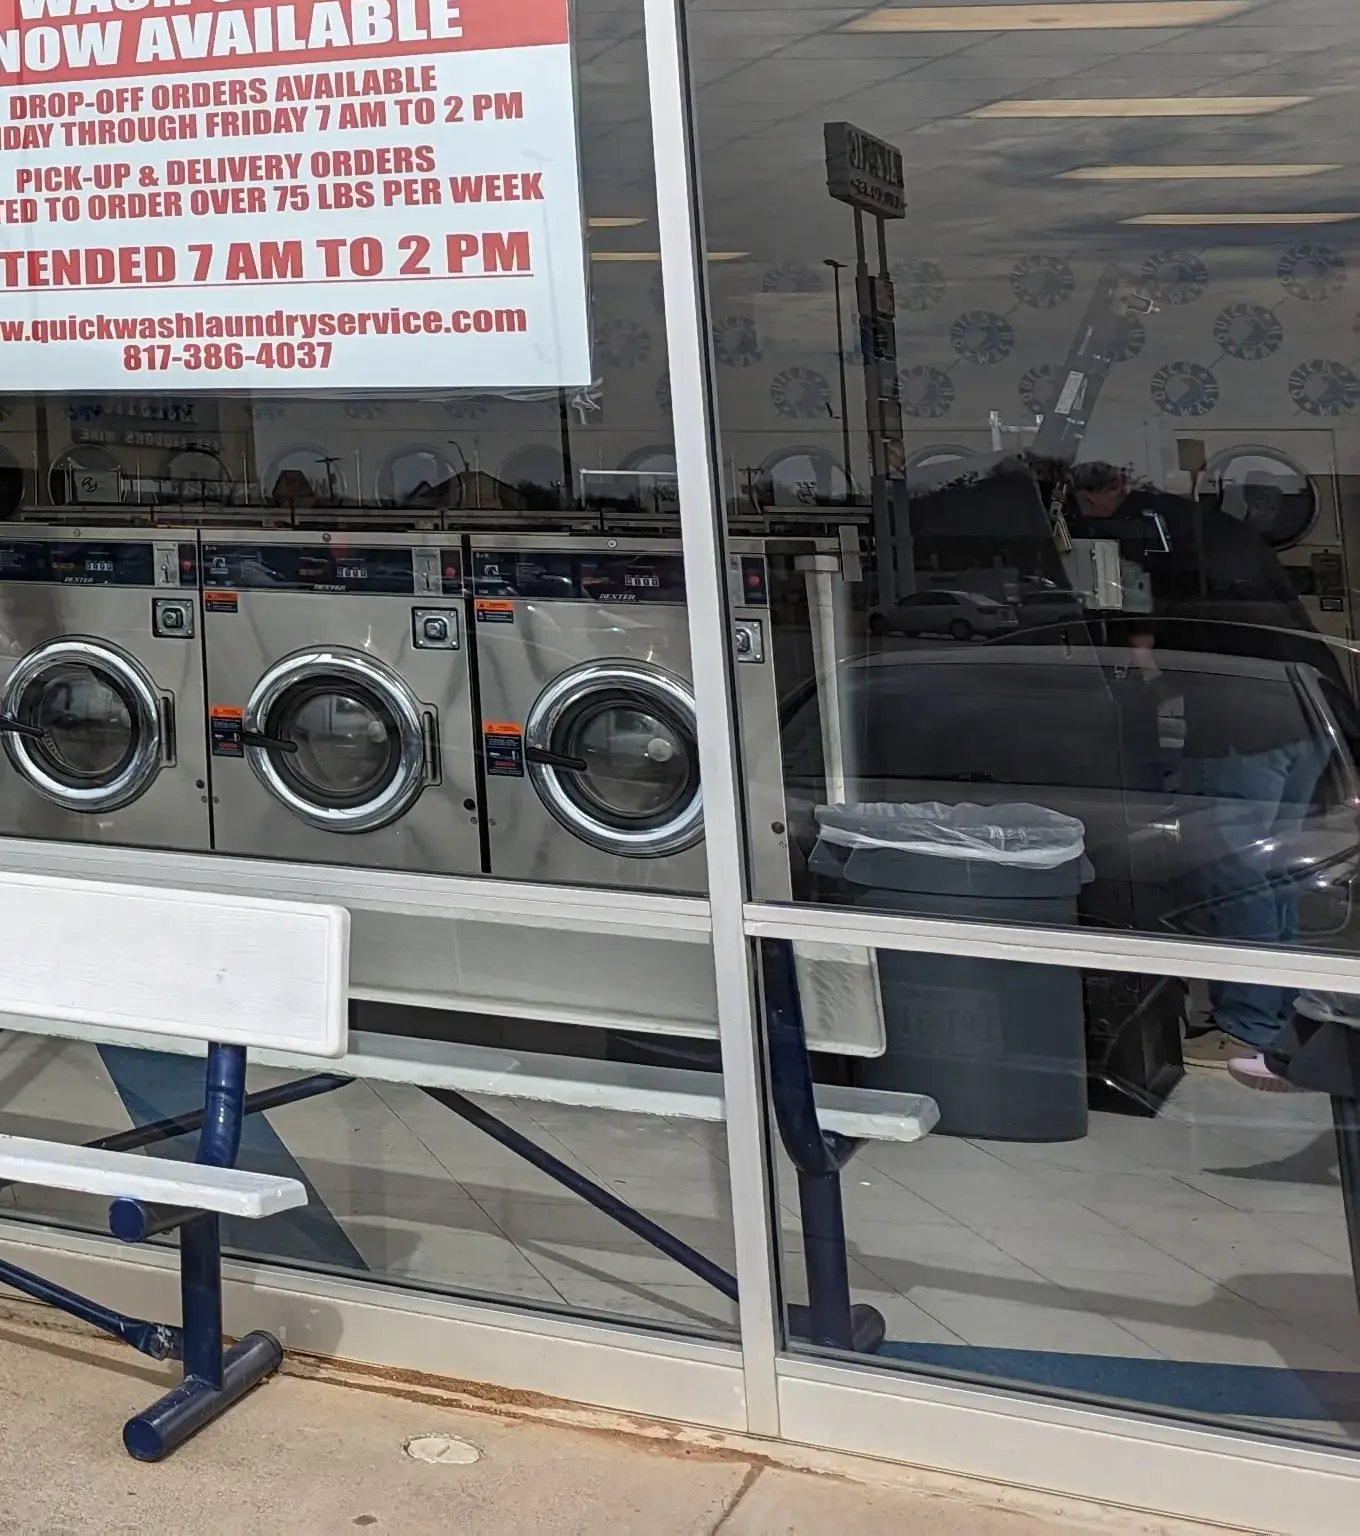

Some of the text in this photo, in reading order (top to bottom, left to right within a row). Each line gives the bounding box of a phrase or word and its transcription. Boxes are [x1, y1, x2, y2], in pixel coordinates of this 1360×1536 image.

[9, 66, 436, 121] DROP-OFF ORDERS AVAILABLE
[62, 115, 196, 149] THROUGH
[206, 108, 308, 139] FRIDAY
[316, 106, 330, 132] 7
[338, 102, 383, 130] AM
[393, 99, 435, 126] TO
[443, 96, 463, 122] 2
[473, 92, 523, 120] PM
[16, 144, 435, 194] PICK-UP & DELIVERY ORDERS
[45, 195, 80, 221] TO
[87, 191, 182, 220] ORDER
[190, 186, 266, 216] OVER
[273, 185, 310, 213] 75
[318, 182, 376, 210] LBS
[383, 177, 443, 206] PER
[450, 172, 544, 203] WEEK
[188, 244, 214, 282] 7
[227, 240, 303, 280] AM
[316, 237, 384, 278] TO
[398, 235, 432, 275] 2
[446, 231, 531, 273] PM
[123, 342, 333, 372] 817-386-4037
[1151, 362, 1192, 400] QUICK
[600, 593, 636, 601] DEXTER
